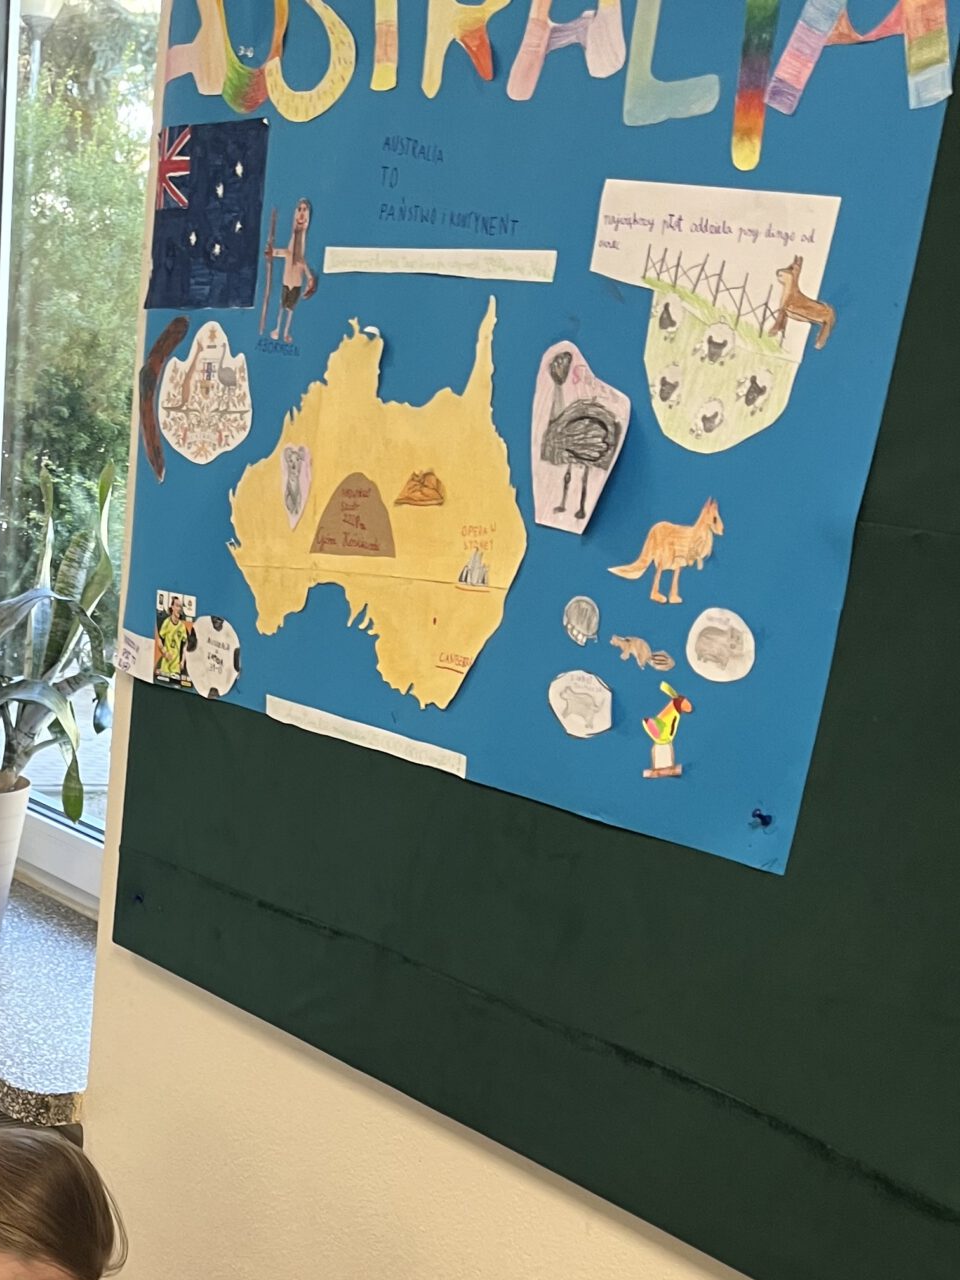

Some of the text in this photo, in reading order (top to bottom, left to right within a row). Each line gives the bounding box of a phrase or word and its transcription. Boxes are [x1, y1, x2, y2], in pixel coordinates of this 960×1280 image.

[382, 136, 444, 164] AUSTRALIA
[381, 166, 399, 189] TO
[378, 197, 437, 225] PAŃSTWO
